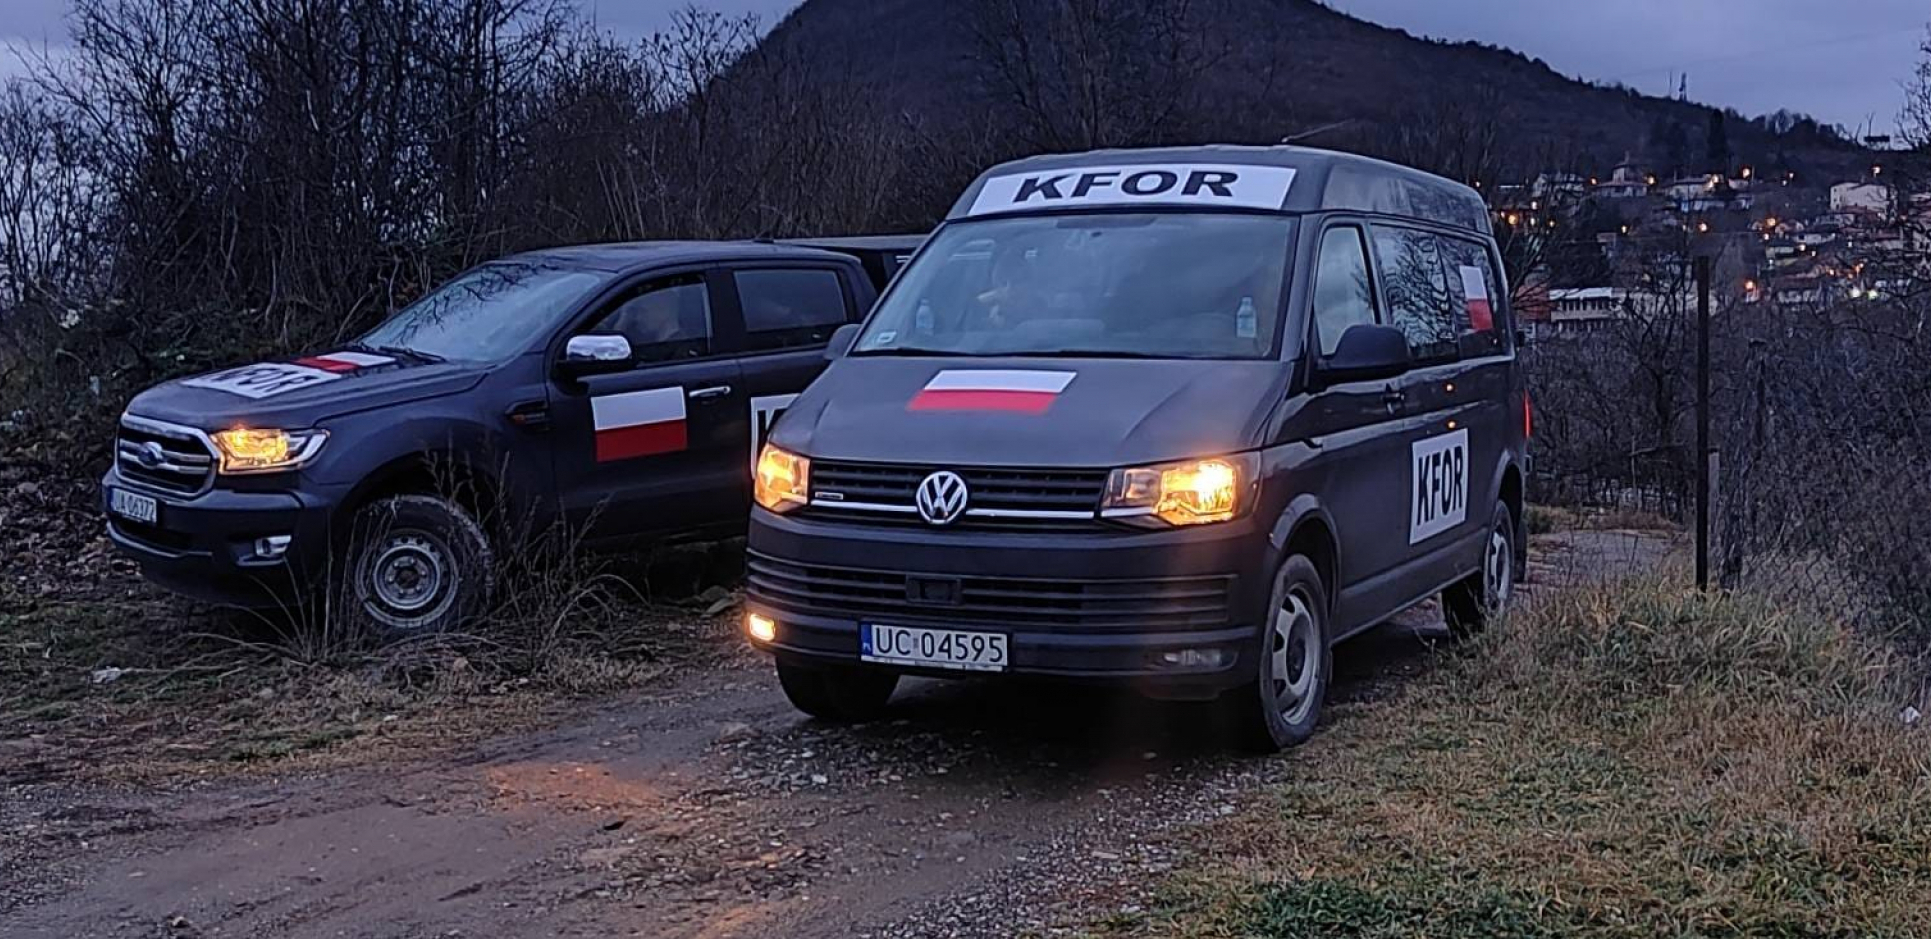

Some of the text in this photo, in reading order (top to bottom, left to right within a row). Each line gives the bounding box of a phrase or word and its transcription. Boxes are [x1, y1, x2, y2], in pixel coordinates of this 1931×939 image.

[1013, 171, 1238, 202] KFOR
[1417, 446, 1463, 525] KFOR
[876, 628, 911, 655] UC
[921, 632, 1003, 662] 04595
